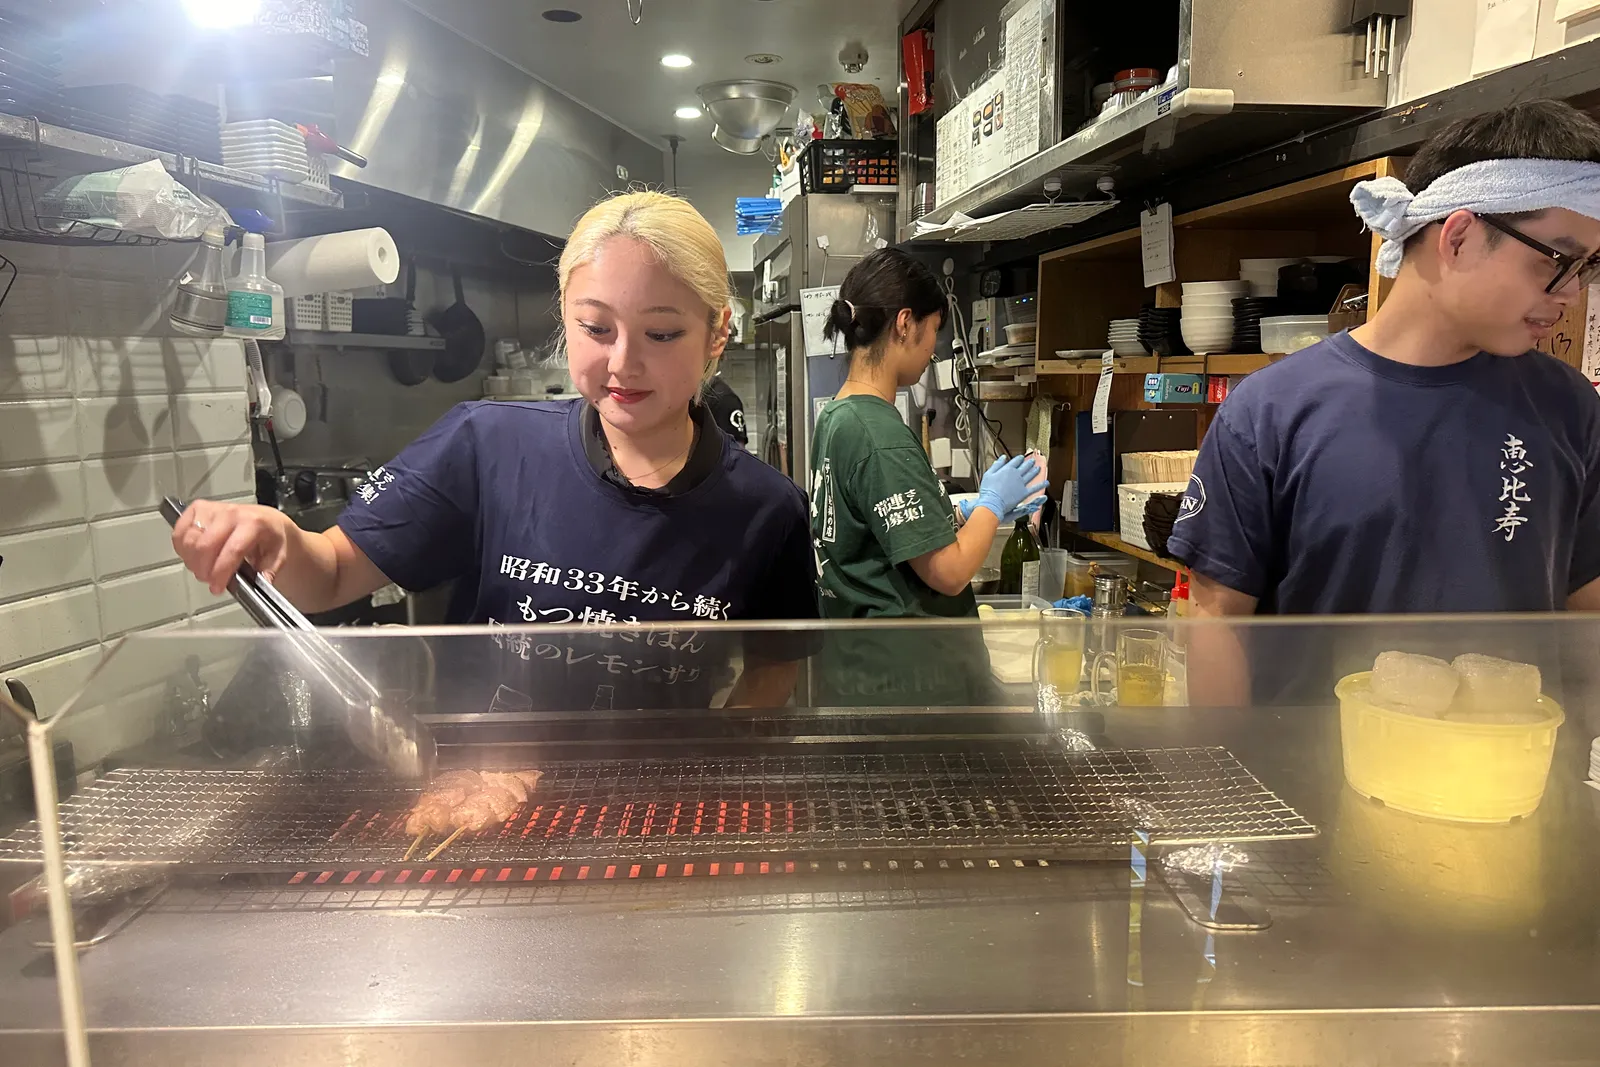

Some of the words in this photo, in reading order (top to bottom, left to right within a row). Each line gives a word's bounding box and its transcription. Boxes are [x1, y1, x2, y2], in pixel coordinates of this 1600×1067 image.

[1492, 433, 1534, 542] 恵比寿
[500, 554, 732, 622] 昭和33年から続く
